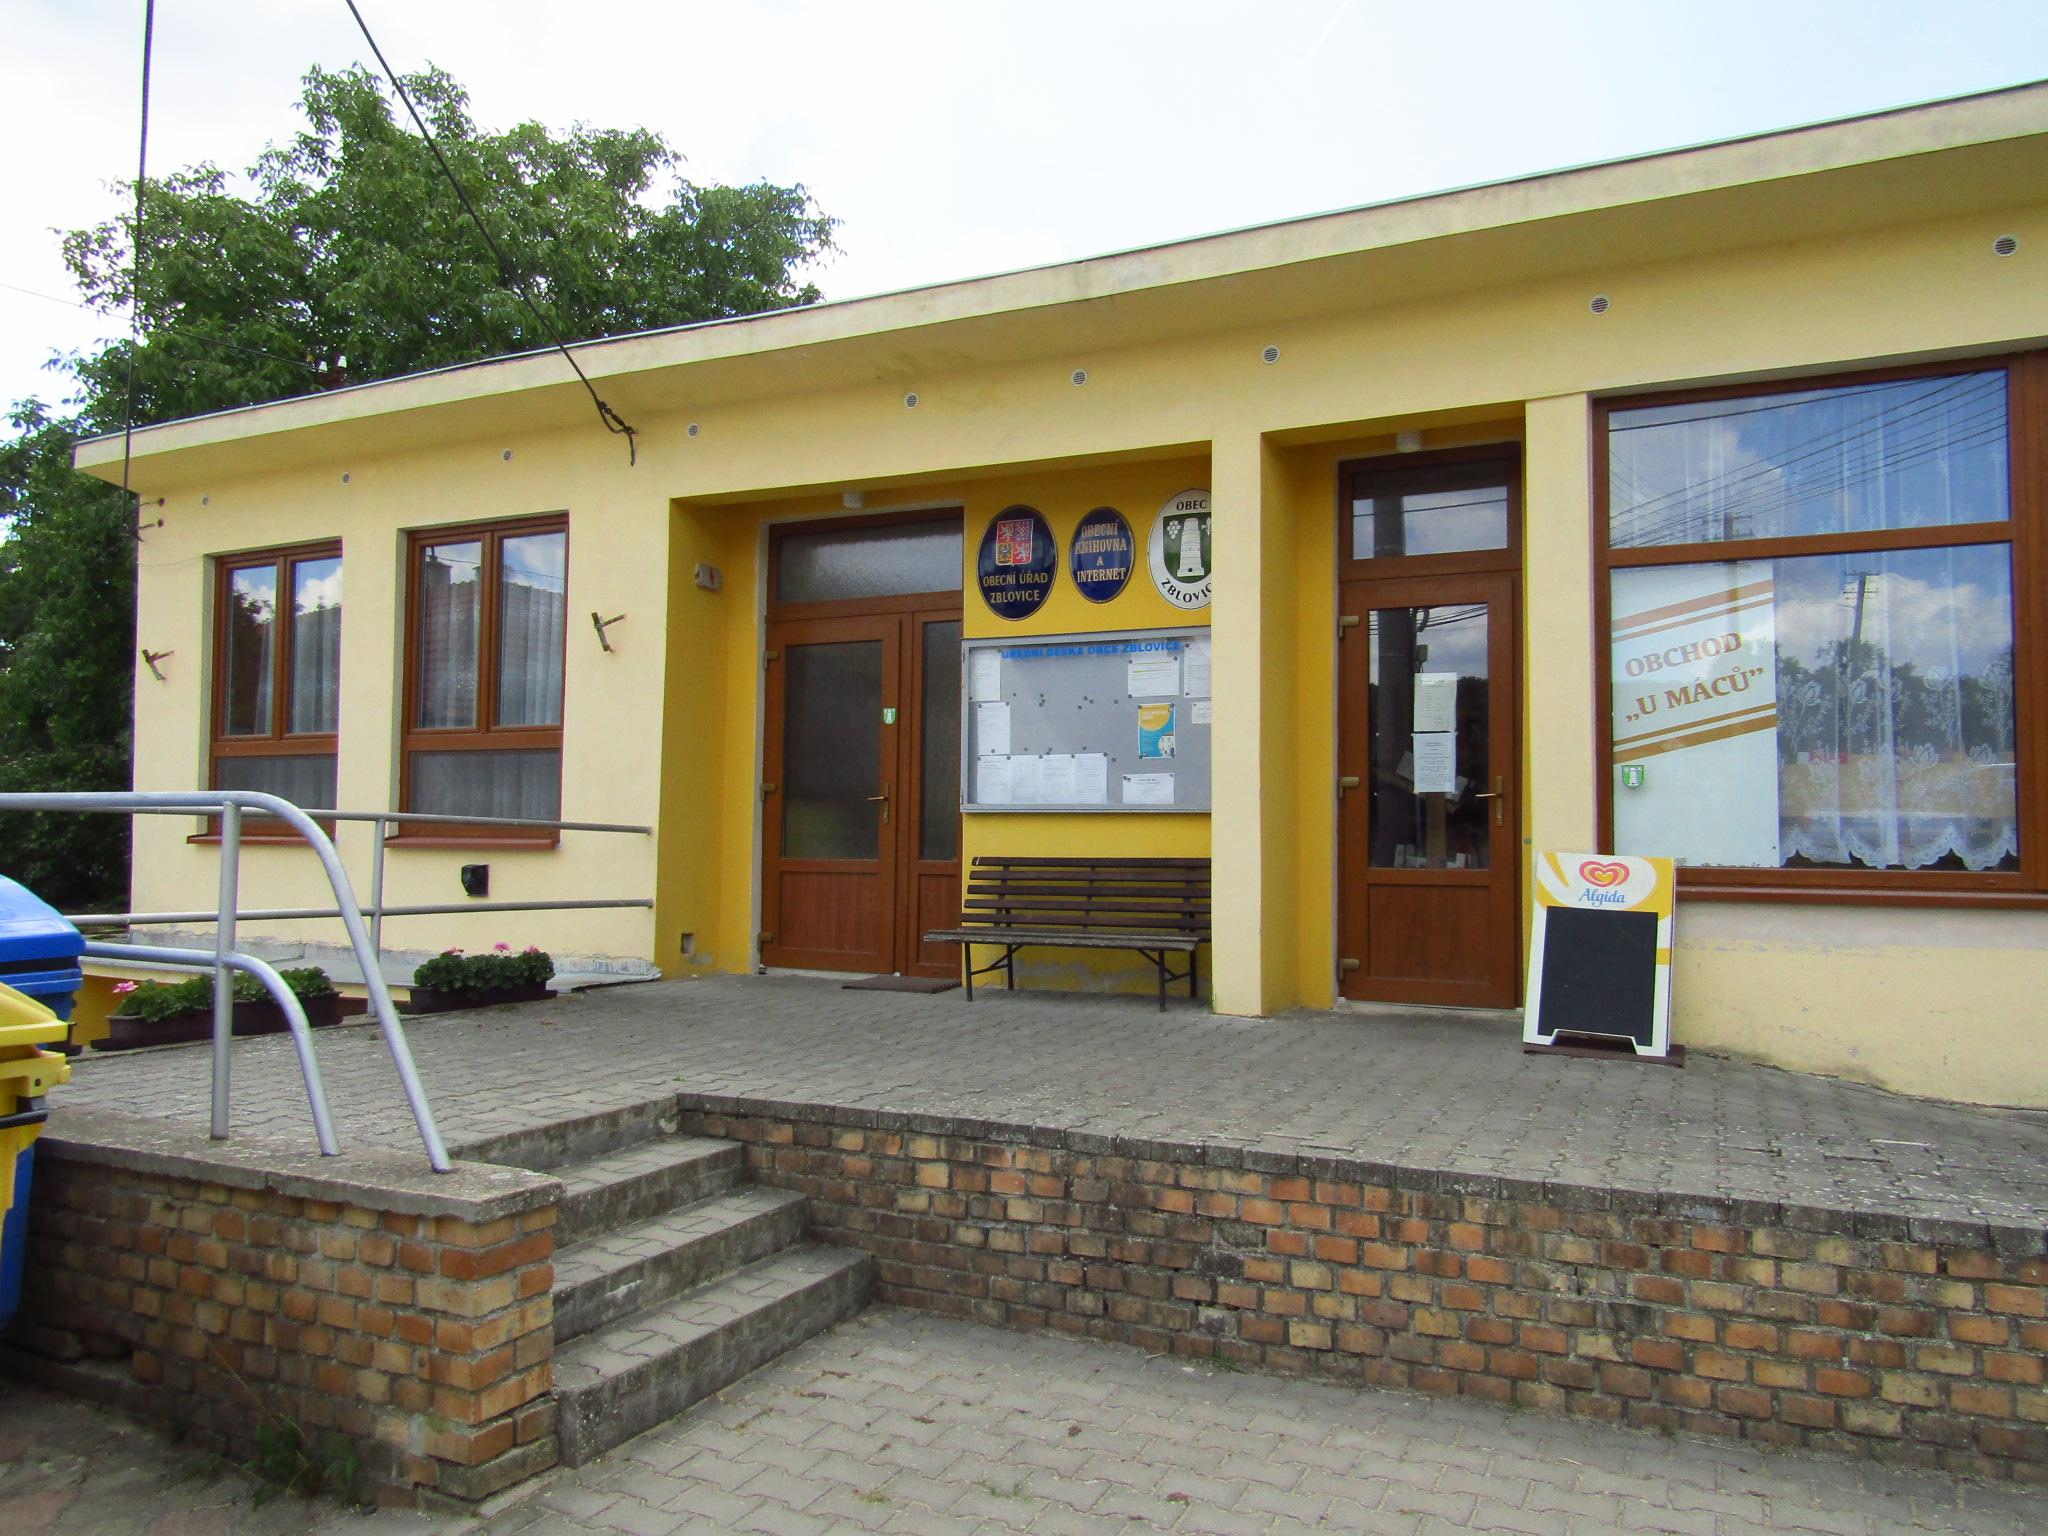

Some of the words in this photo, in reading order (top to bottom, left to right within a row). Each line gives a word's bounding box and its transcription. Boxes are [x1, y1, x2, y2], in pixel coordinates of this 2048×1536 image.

[1176, 500, 1208, 512] OBEC
[1081, 519, 1118, 538] OBECNÍ
[1075, 538, 1127, 555] KNIHOVNA
[1096, 556, 1104, 566] A
[983, 571, 1016, 587] OBECNÍ
[1019, 569, 1048, 584] ÚŘAD
[1077, 567, 1126, 583] INTERNET
[990, 590, 1040, 604] ZBLOVICE
[1161, 578, 1212, 603] ZBLOVIC
[1122, 640, 1182, 653] ZBLOVICE
[1625, 632, 1743, 677] OBCHOD
[1578, 888, 1626, 907] Algida
